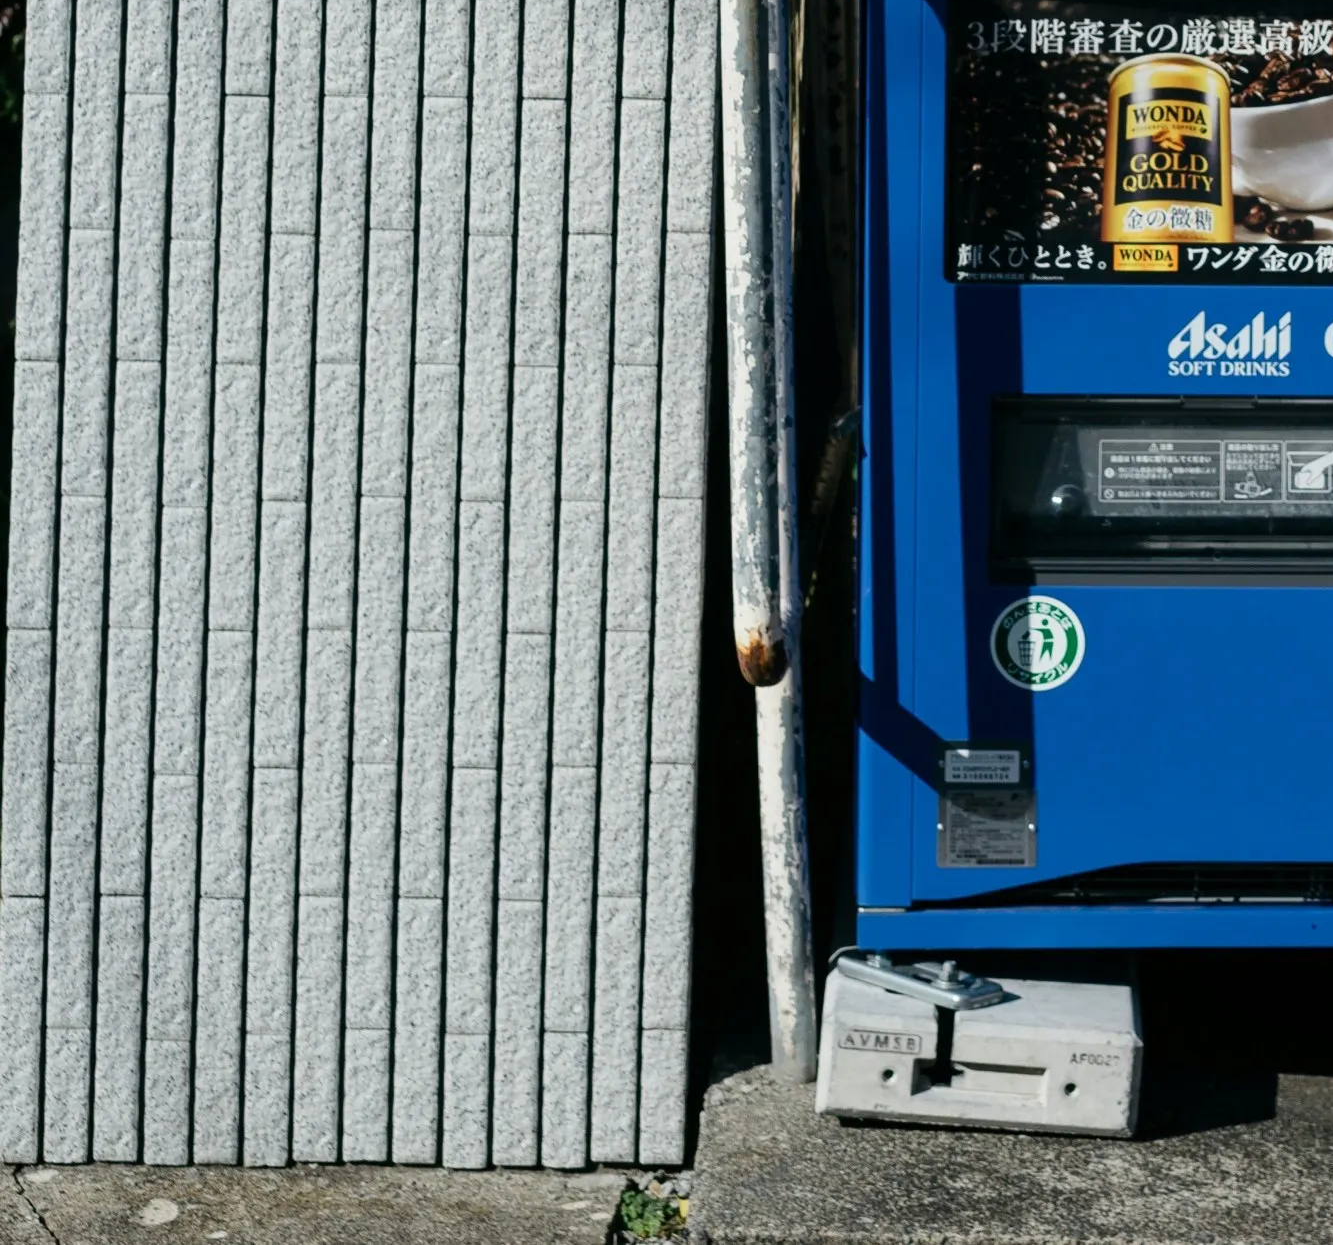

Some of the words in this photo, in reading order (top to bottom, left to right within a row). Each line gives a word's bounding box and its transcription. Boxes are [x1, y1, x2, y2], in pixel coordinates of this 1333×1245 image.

[1132, 105, 1207, 126] WONDA
[1130, 151, 1210, 174] GOLD
[1122, 172, 1215, 193] QUALITY
[1126, 207, 1213, 231] 金の微糖
[1119, 250, 1173, 262] WONDA
[1168, 310, 1291, 360] Asahi
[1168, 361, 1216, 376] SOFT
[1220, 361, 1290, 377] DRINKS
[844, 1034, 916, 1051] AVMSB
